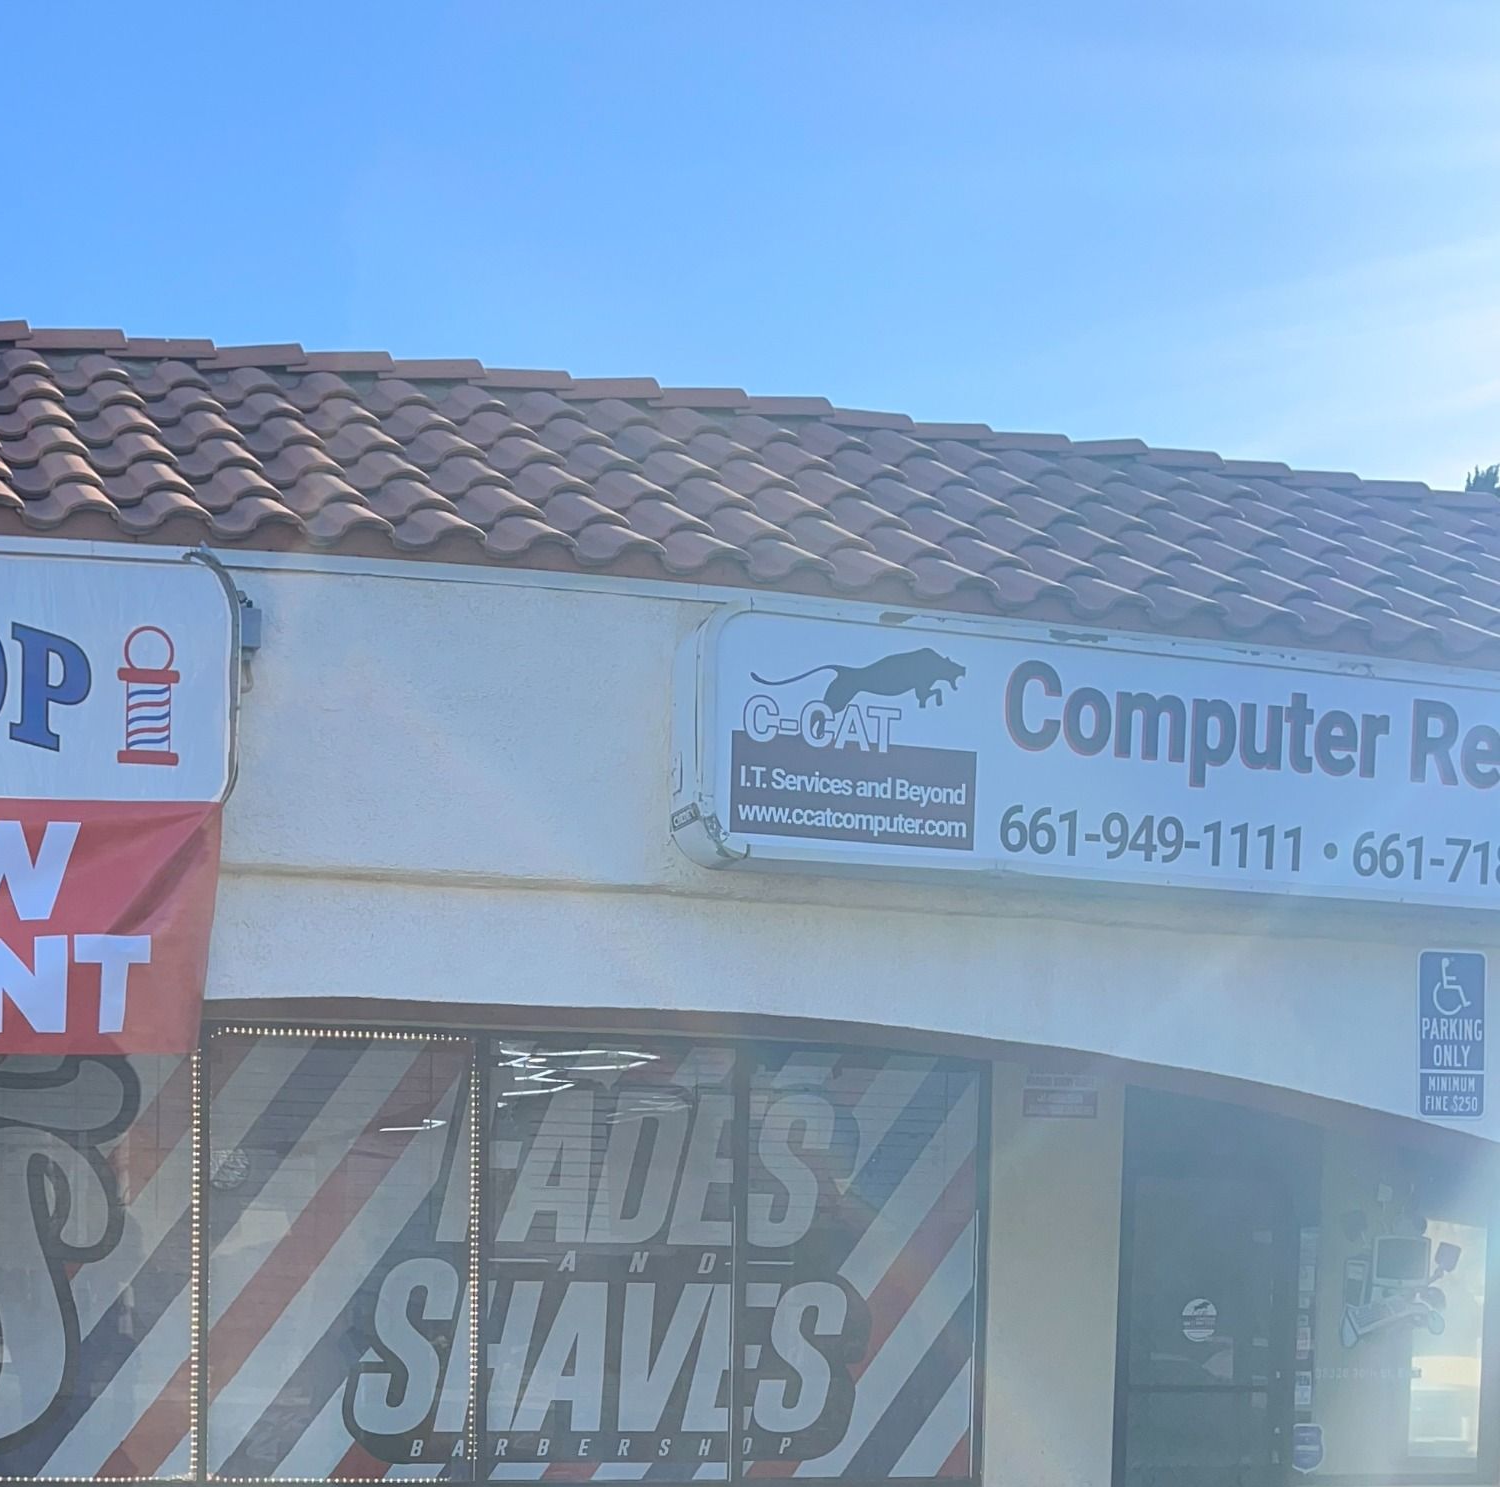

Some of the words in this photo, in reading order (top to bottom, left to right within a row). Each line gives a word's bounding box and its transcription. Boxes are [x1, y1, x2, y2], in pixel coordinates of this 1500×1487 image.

[742, 694, 902, 753] C-CAT
[1004, 659, 1390, 788] Computer
[739, 765, 767, 788] I.T.
[771, 768, 853, 796] Services
[856, 775, 892, 799] and
[895, 779, 967, 806] Beyond
[738, 803, 967, 838] www.ccatcomputer.com
[999, 804, 1303, 872] 661-949-1111
[1352, 831, 1500, 885] 661-71
[1421, 1017, 1483, 1041] PARKING
[1433, 1045, 1471, 1067] ONLY
[1428, 1075, 1476, 1093] MINIMUM
[1425, 1095, 1449, 1111] FINE
[1453, 1095, 1478, 1113] $250
